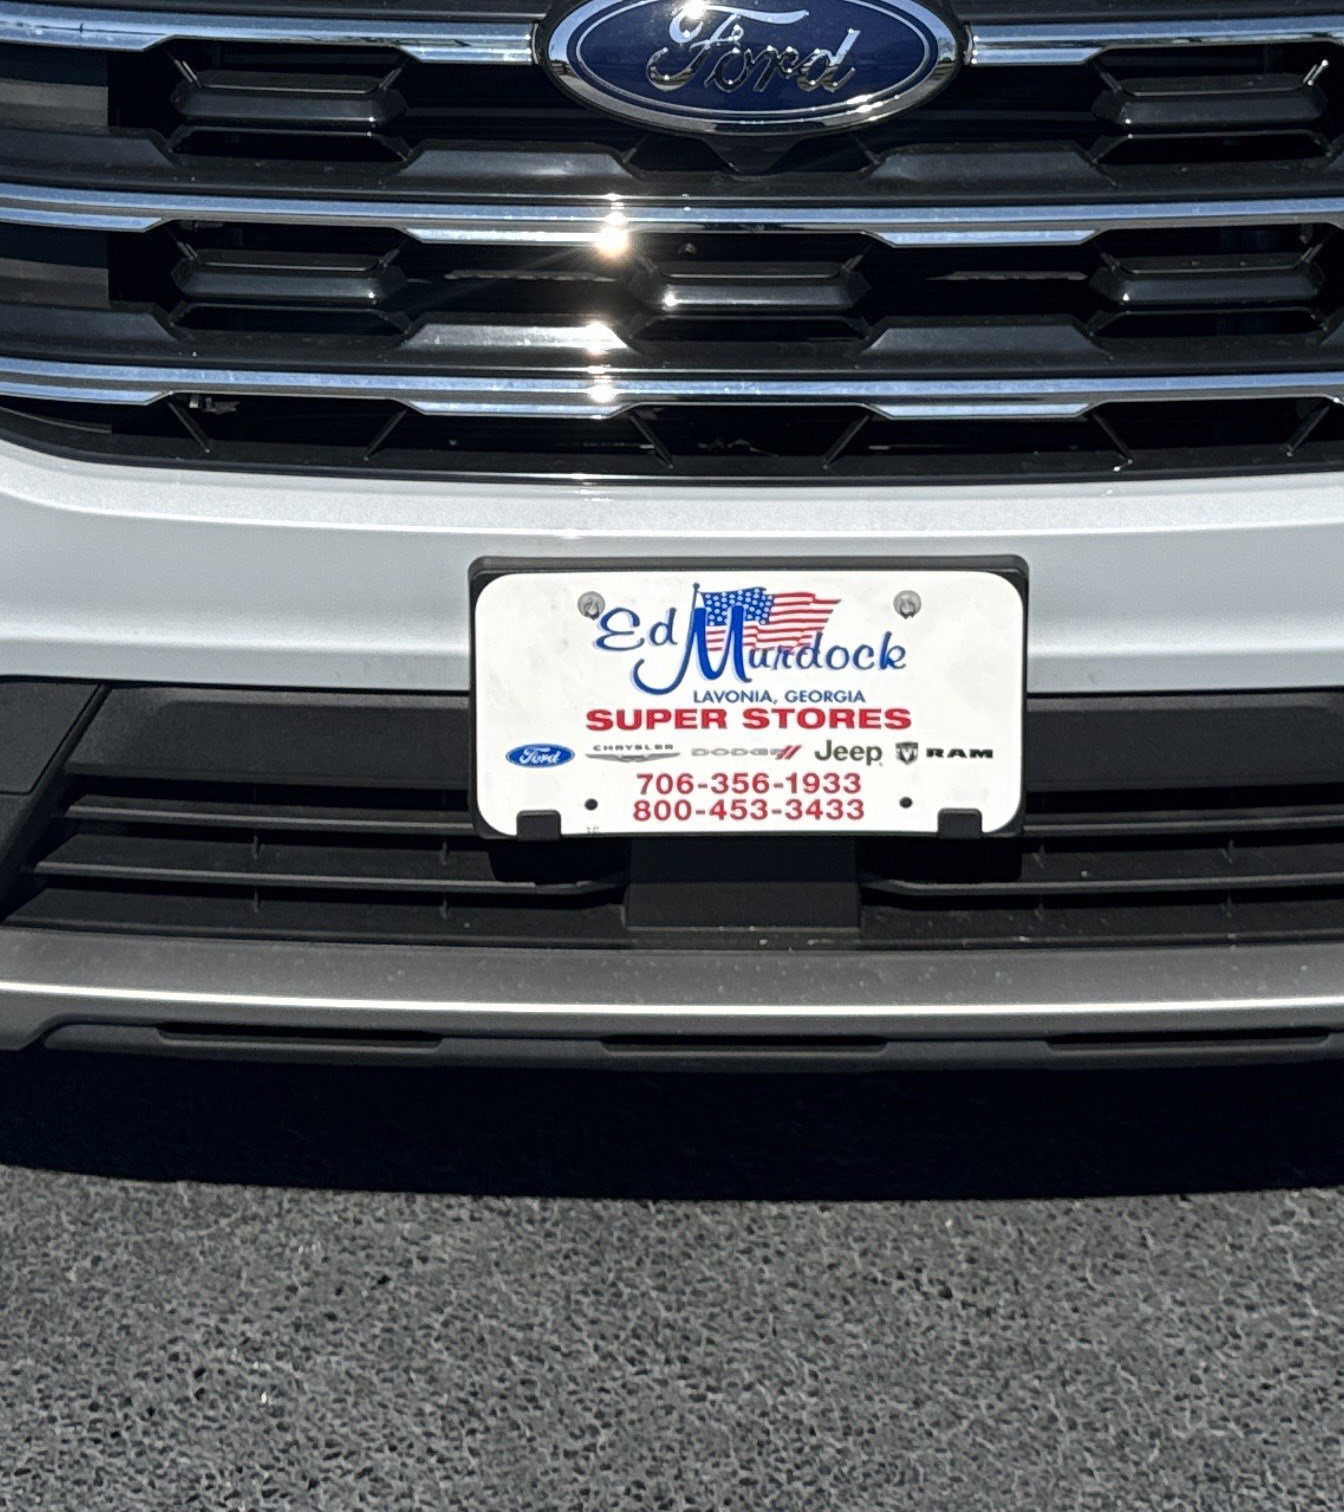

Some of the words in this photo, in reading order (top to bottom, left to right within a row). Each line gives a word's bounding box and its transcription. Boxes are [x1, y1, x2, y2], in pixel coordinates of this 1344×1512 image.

[646, 0, 861, 92] Ford
[593, 606, 678, 652] Ed
[632, 603, 907, 696] Murdock
[693, 689, 778, 705] LAVONIA,
[784, 689, 866, 703] GEORGIA
[585, 708, 728, 731] SUPER
[742, 708, 912, 730] STORES
[518, 747, 562, 765] Ford
[814, 739, 883, 766] Jeep
[926, 747, 994, 759] RAM
[636, 772, 862, 795] 706-356-1933
[632, 798, 865, 822] 800-453-3433
